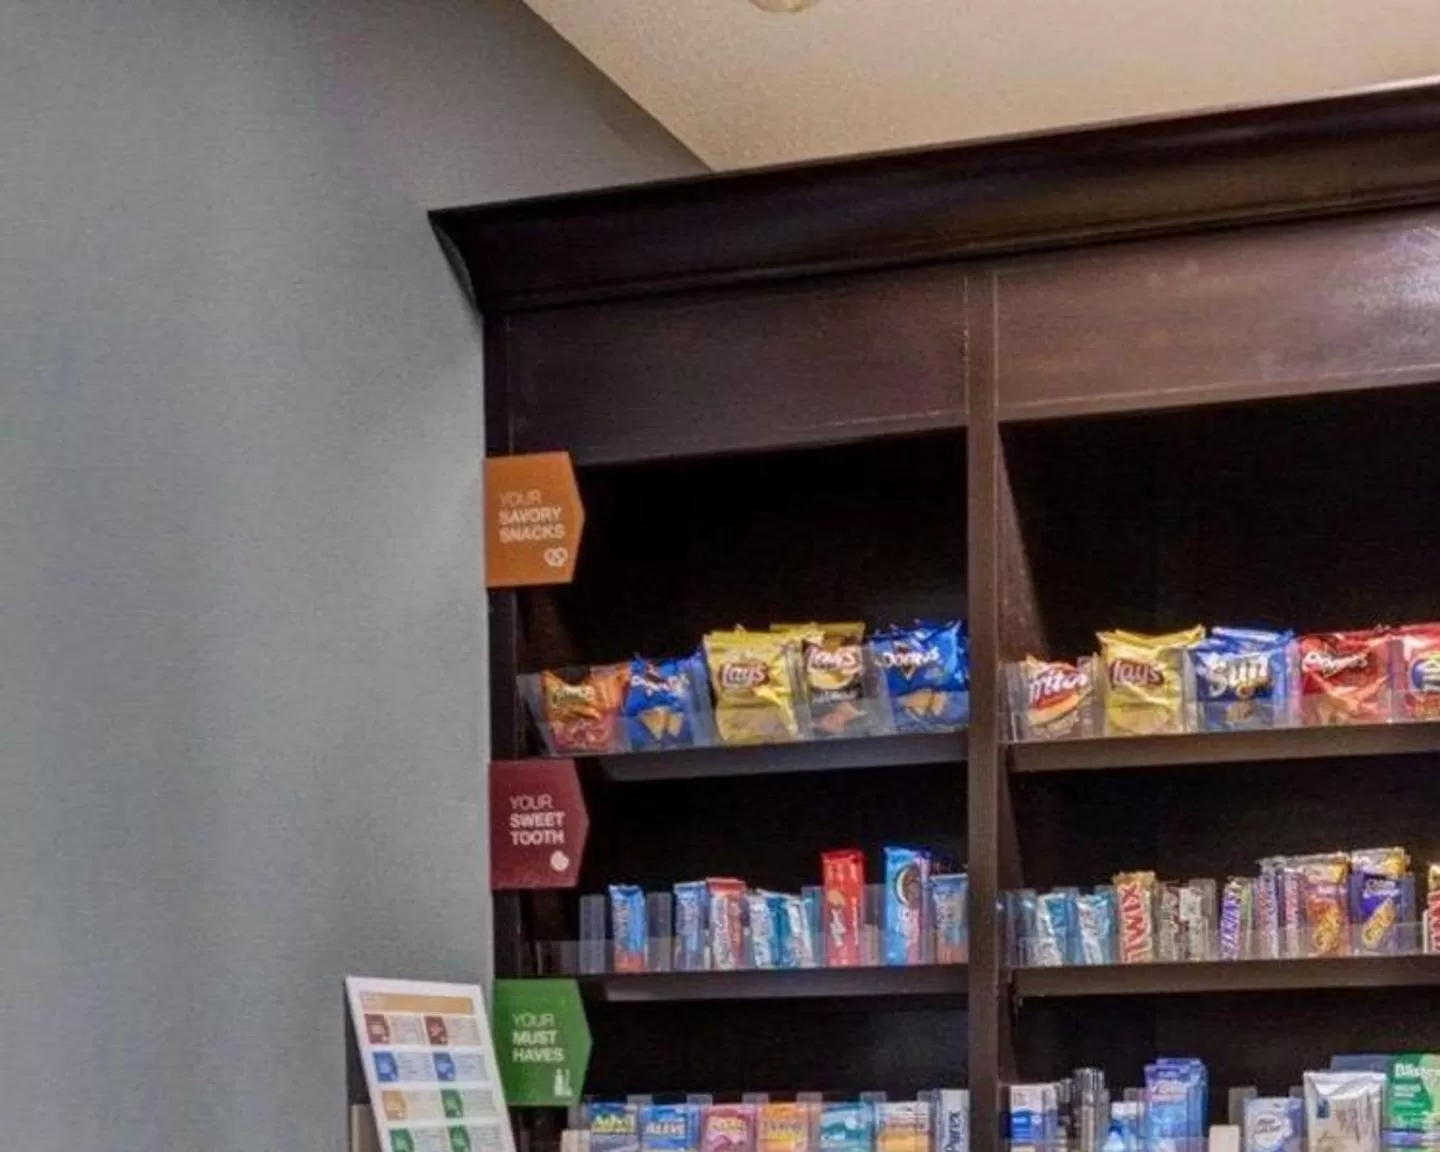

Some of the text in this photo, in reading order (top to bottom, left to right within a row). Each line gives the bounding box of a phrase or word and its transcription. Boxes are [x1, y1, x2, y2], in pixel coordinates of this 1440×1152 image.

[500, 489, 541, 507] YOUR
[499, 505, 563, 527] SAVORY
[499, 523, 565, 544] SNACKS
[509, 794, 553, 810] YOUR
[509, 811, 565, 829] SWEET
[509, 828, 565, 846] TOOTH
[511, 1012, 555, 1029] YOUR
[511, 1029, 559, 1046] MUST
[511, 1047, 566, 1063] HAVES
